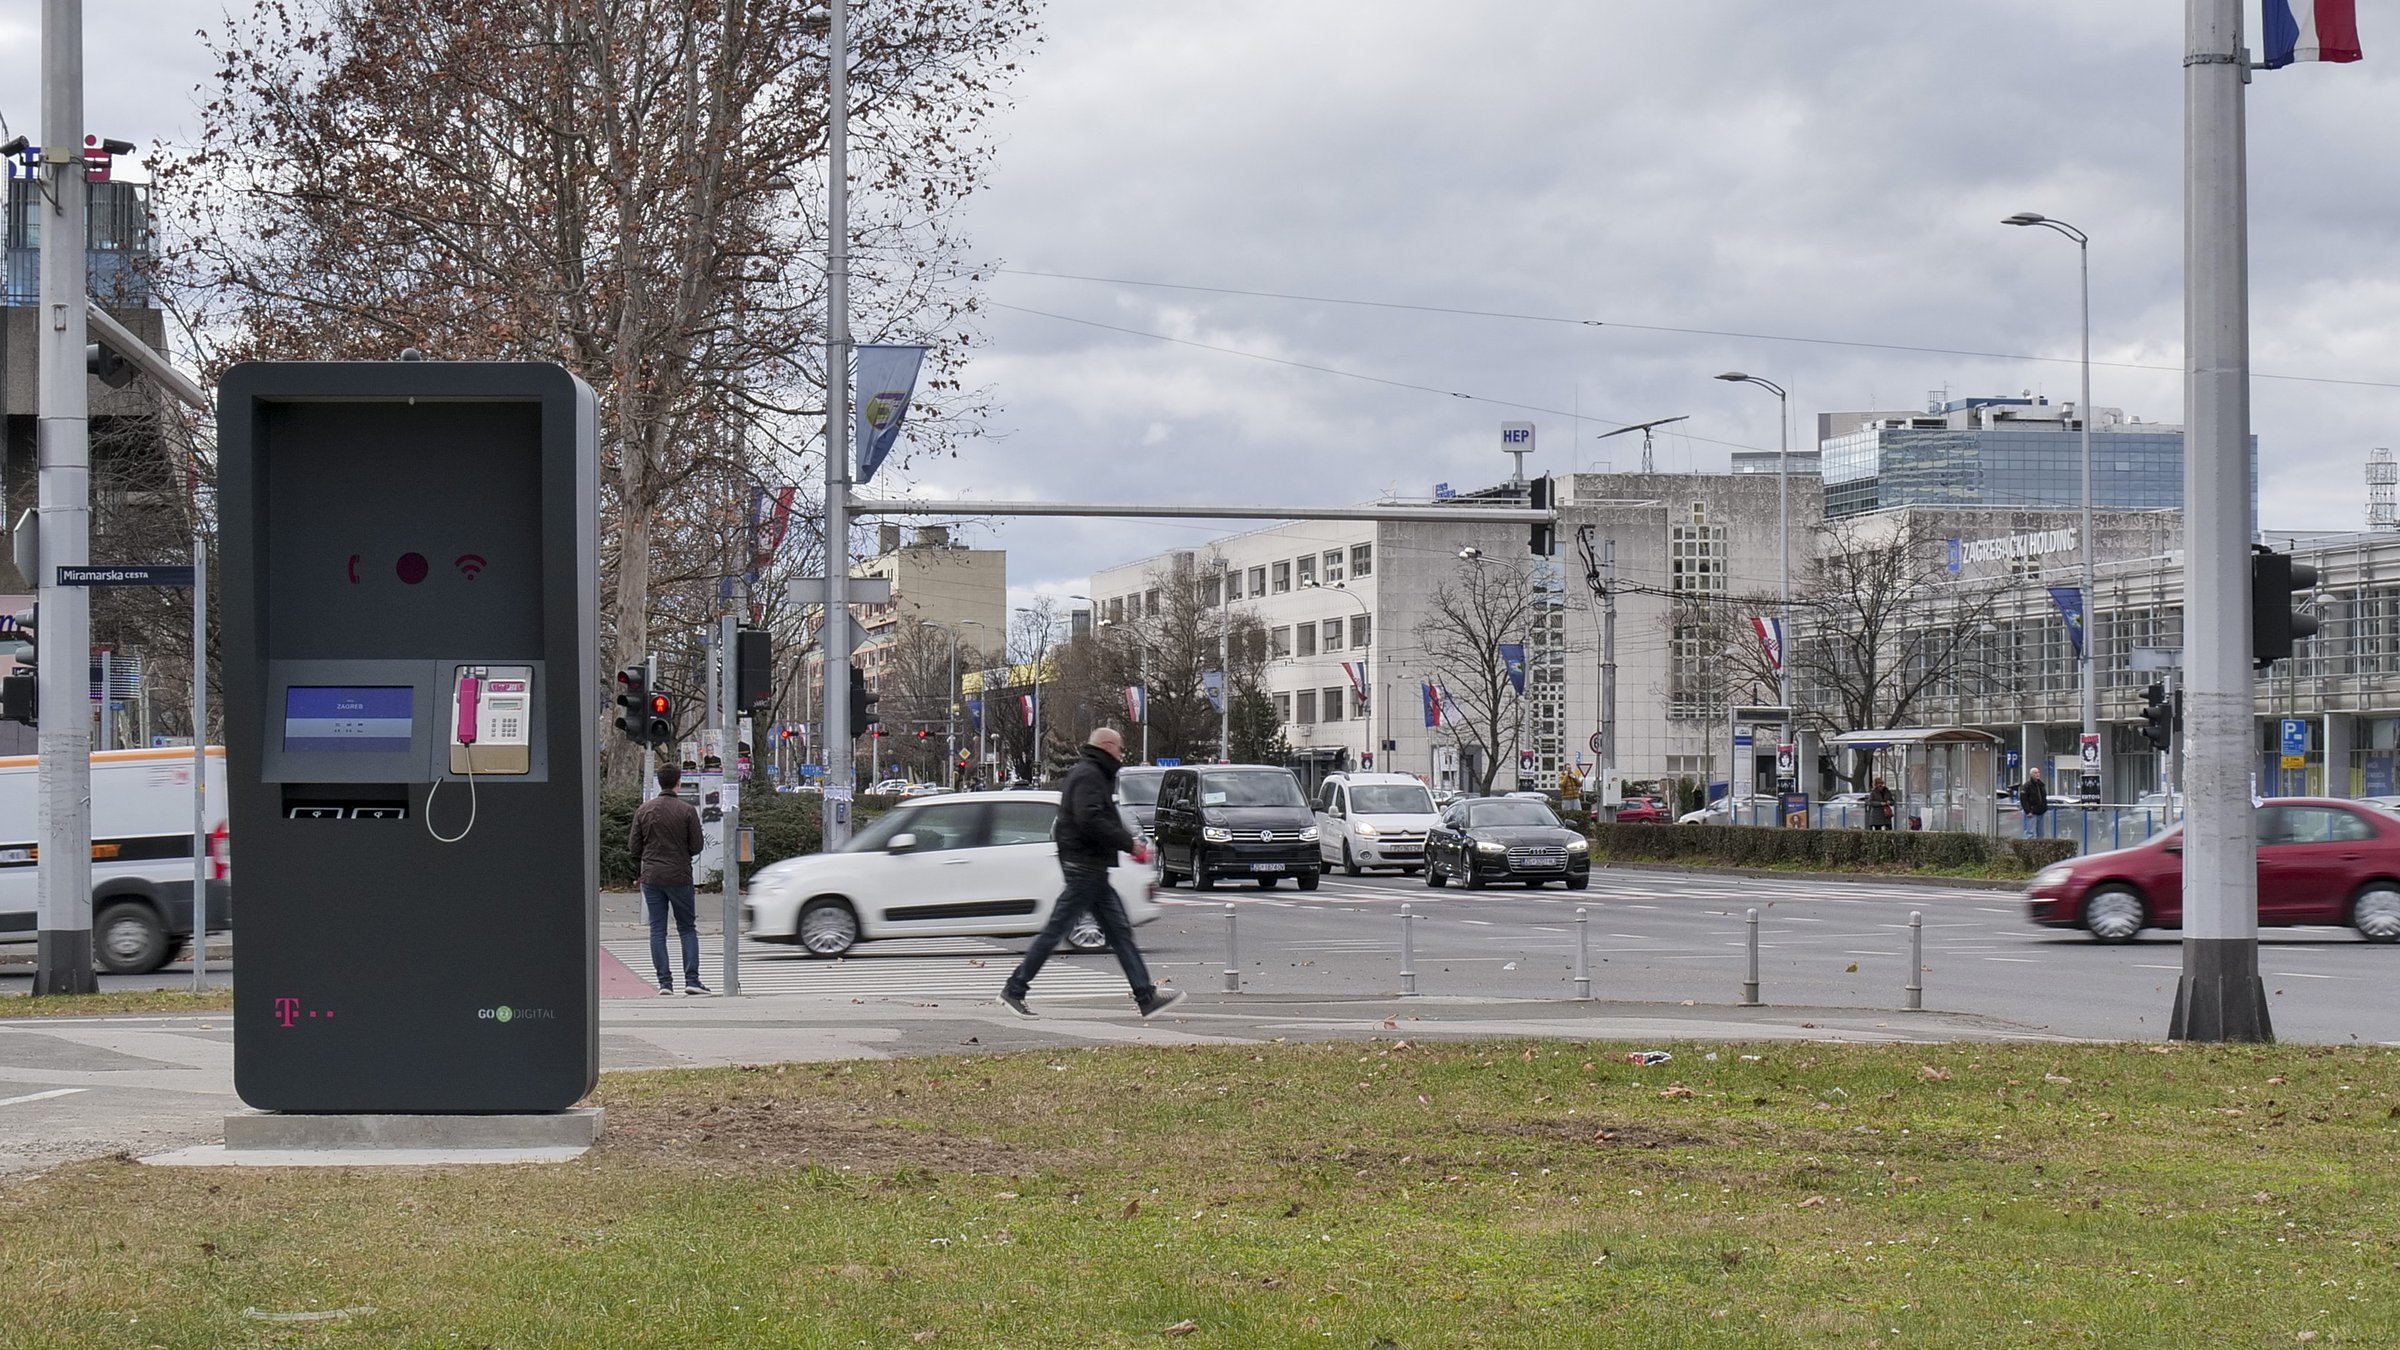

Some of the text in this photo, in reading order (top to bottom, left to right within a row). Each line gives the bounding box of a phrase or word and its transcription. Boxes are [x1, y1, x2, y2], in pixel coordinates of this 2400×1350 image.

[1503, 429, 1529, 443] HEP
[1963, 527, 2077, 564] ZAGREBAČKI HOLDING
[64, 570, 124, 581] Miramarska
[2285, 722, 2297, 740] P
[274, 997, 300, 1028] T
